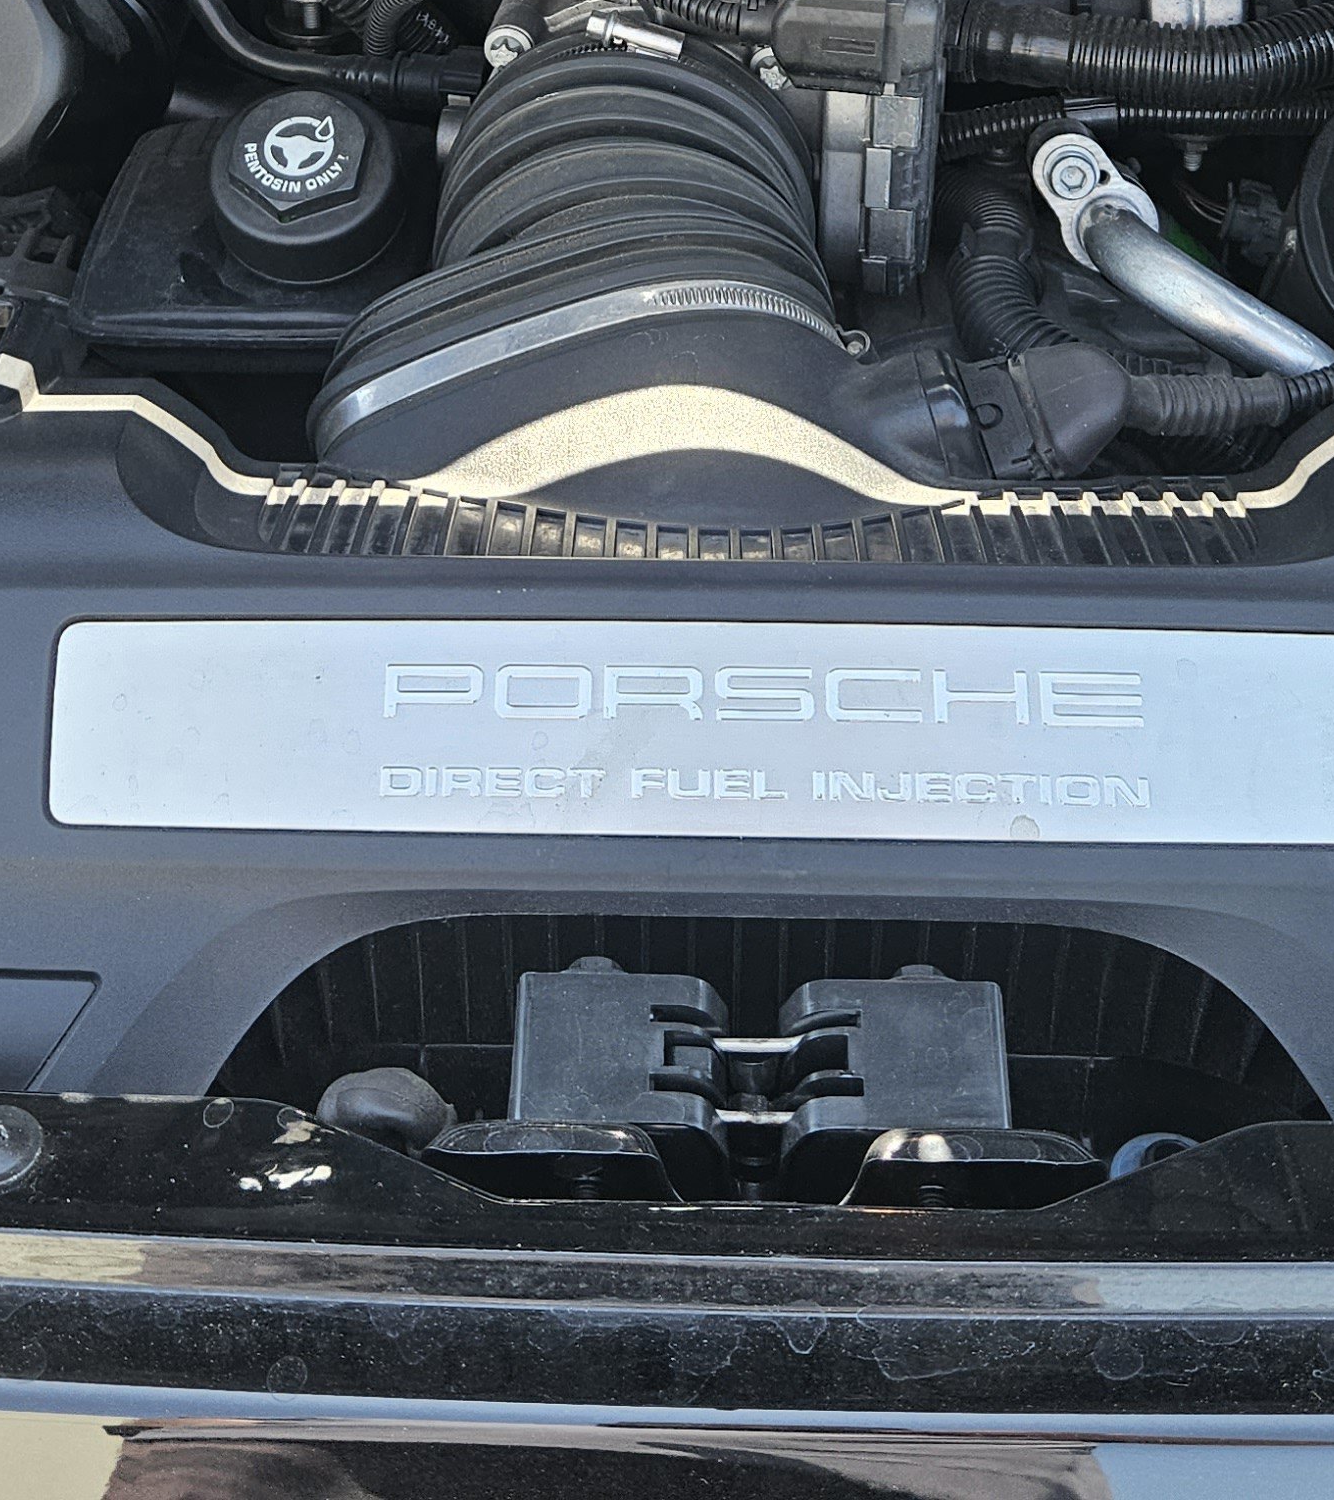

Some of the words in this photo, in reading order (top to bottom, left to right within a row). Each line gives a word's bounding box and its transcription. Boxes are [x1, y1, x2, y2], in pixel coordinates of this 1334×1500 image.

[244, 143, 301, 193] PENTOSIN
[381, 663, 1145, 727] PORSCHE
[378, 765, 606, 799] DIRECT
[629, 766, 789, 801] FUEL
[812, 770, 1152, 809] INJECTION
